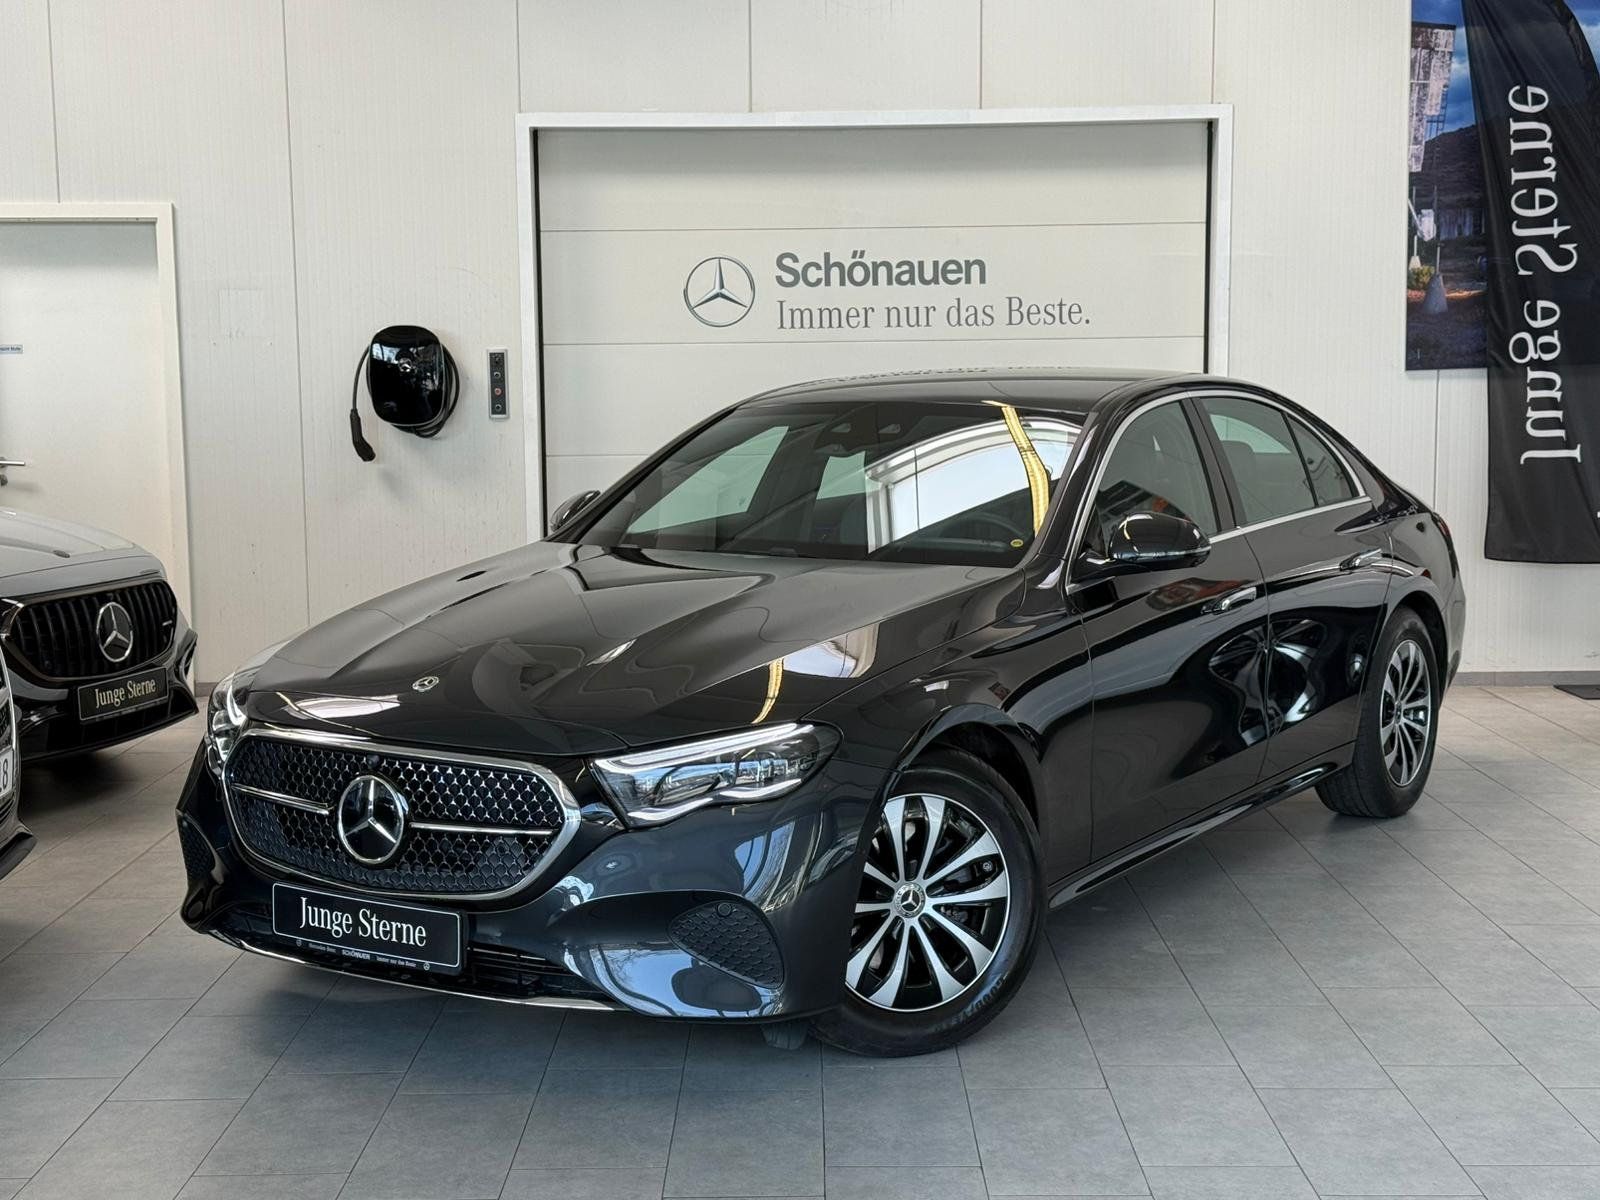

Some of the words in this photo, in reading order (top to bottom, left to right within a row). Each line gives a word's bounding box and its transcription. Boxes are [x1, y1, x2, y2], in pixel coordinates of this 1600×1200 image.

[775, 250, 987, 288] Schönauen
[776, 300, 875, 330] Immer
[884, 305, 936, 328] nur
[946, 297, 995, 328] das
[1005, 296, 1091, 326] Beste.
[94, 688, 125, 709] Junge
[127, 679, 156, 699] Sterne
[299, 896, 353, 939] Junge
[358, 908, 427, 947] Sterne
